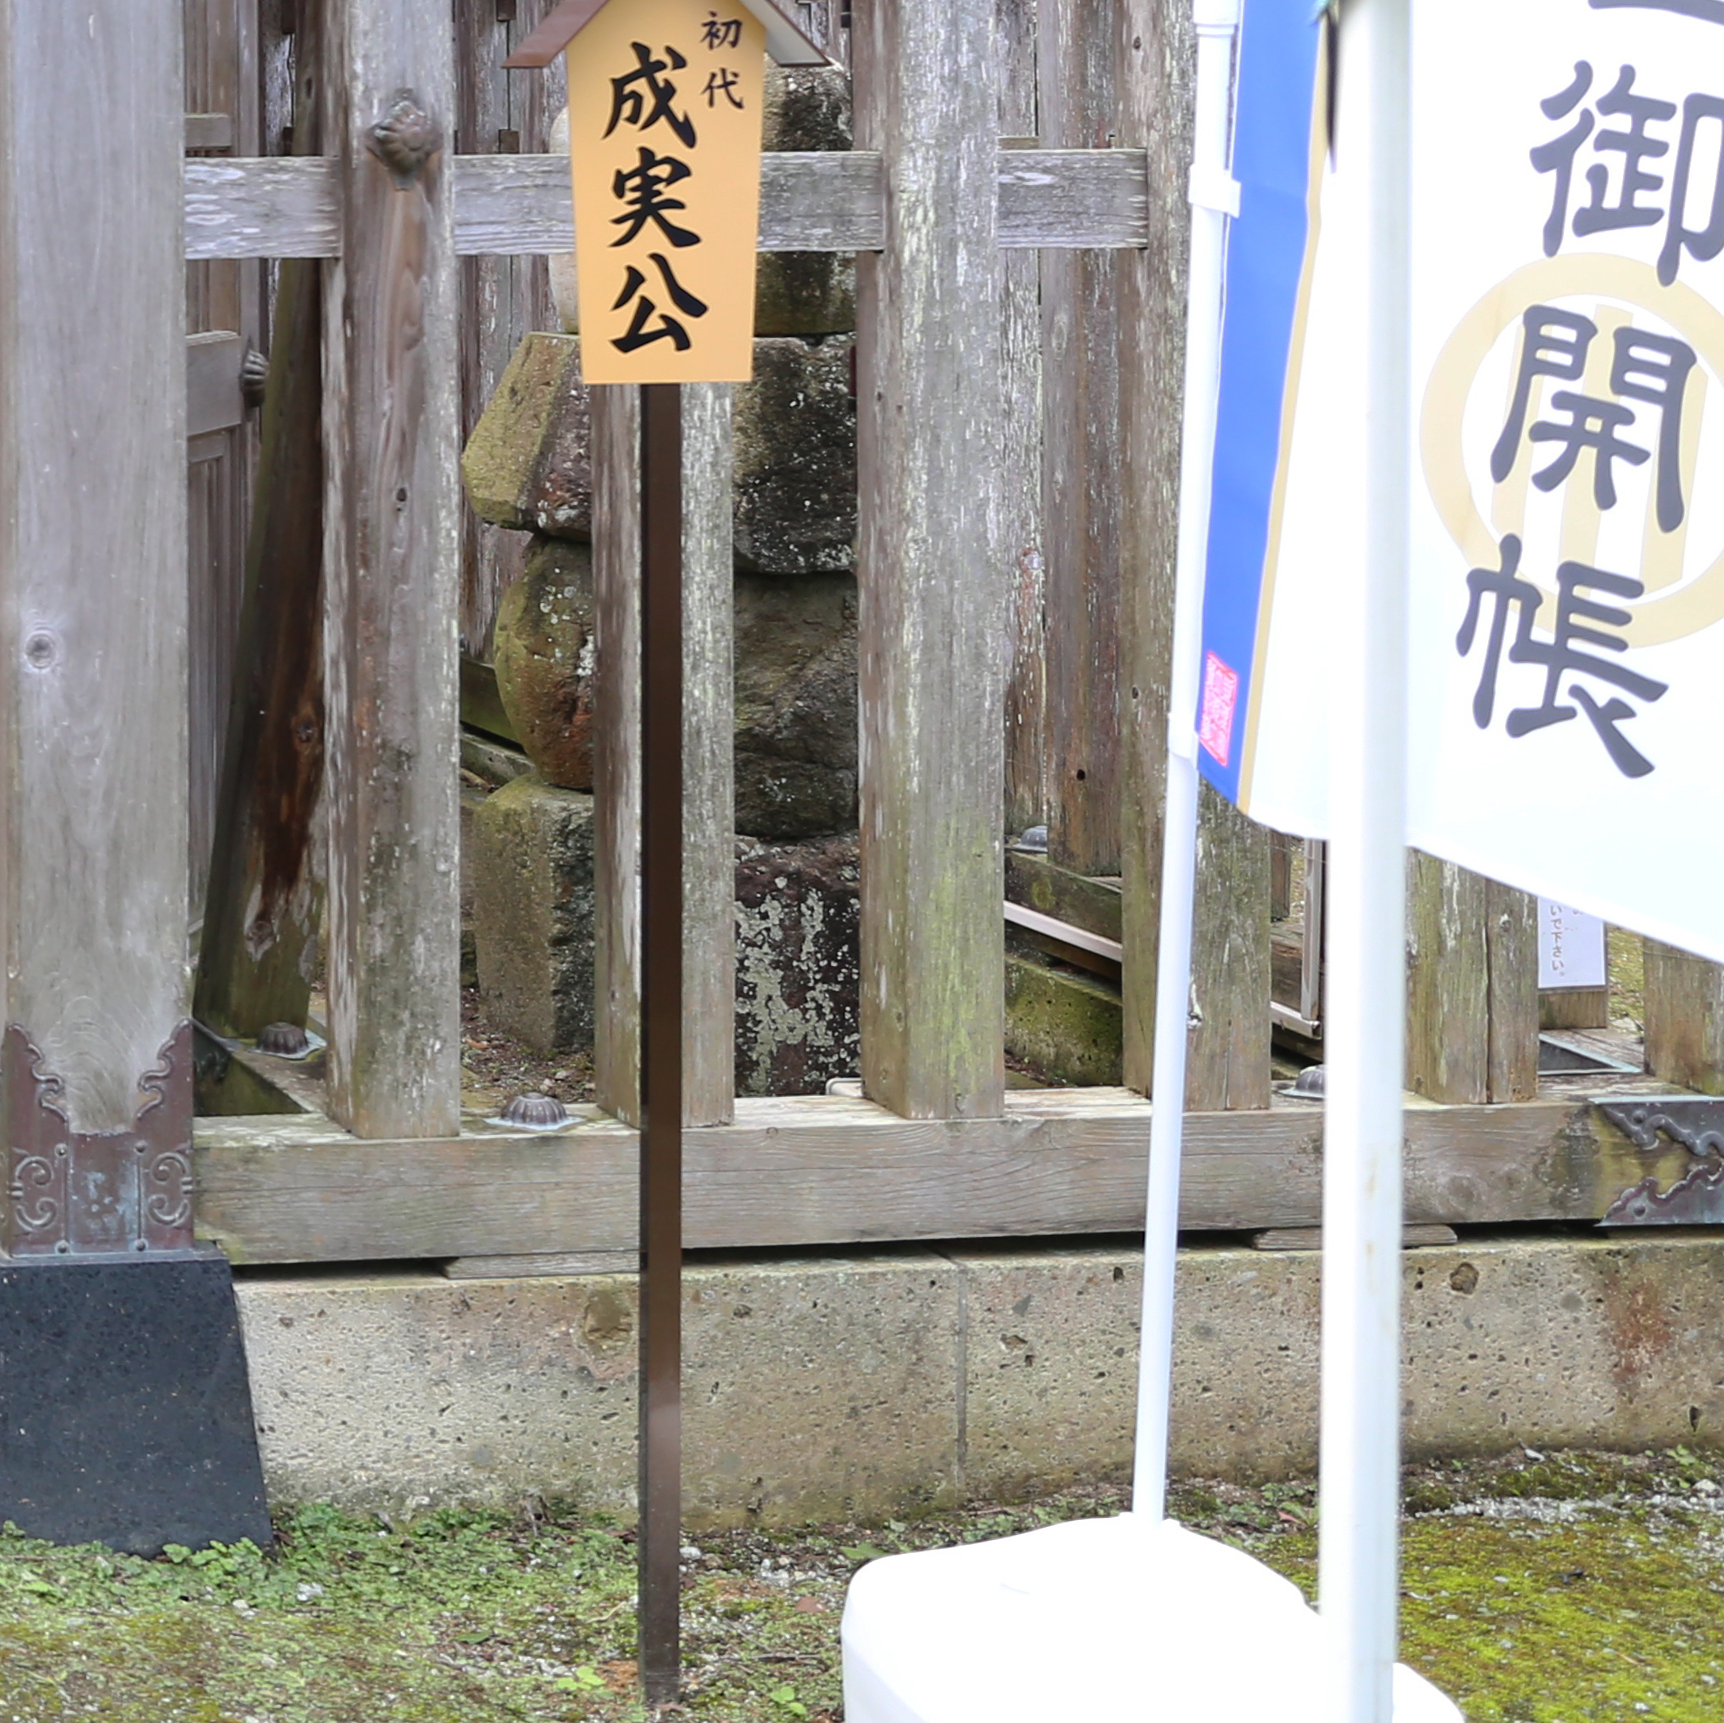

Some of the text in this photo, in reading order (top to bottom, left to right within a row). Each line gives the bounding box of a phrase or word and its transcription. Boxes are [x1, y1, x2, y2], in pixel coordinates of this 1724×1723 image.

[700, 11, 744, 110] 初代
[601, 41, 709, 354] 成実公
